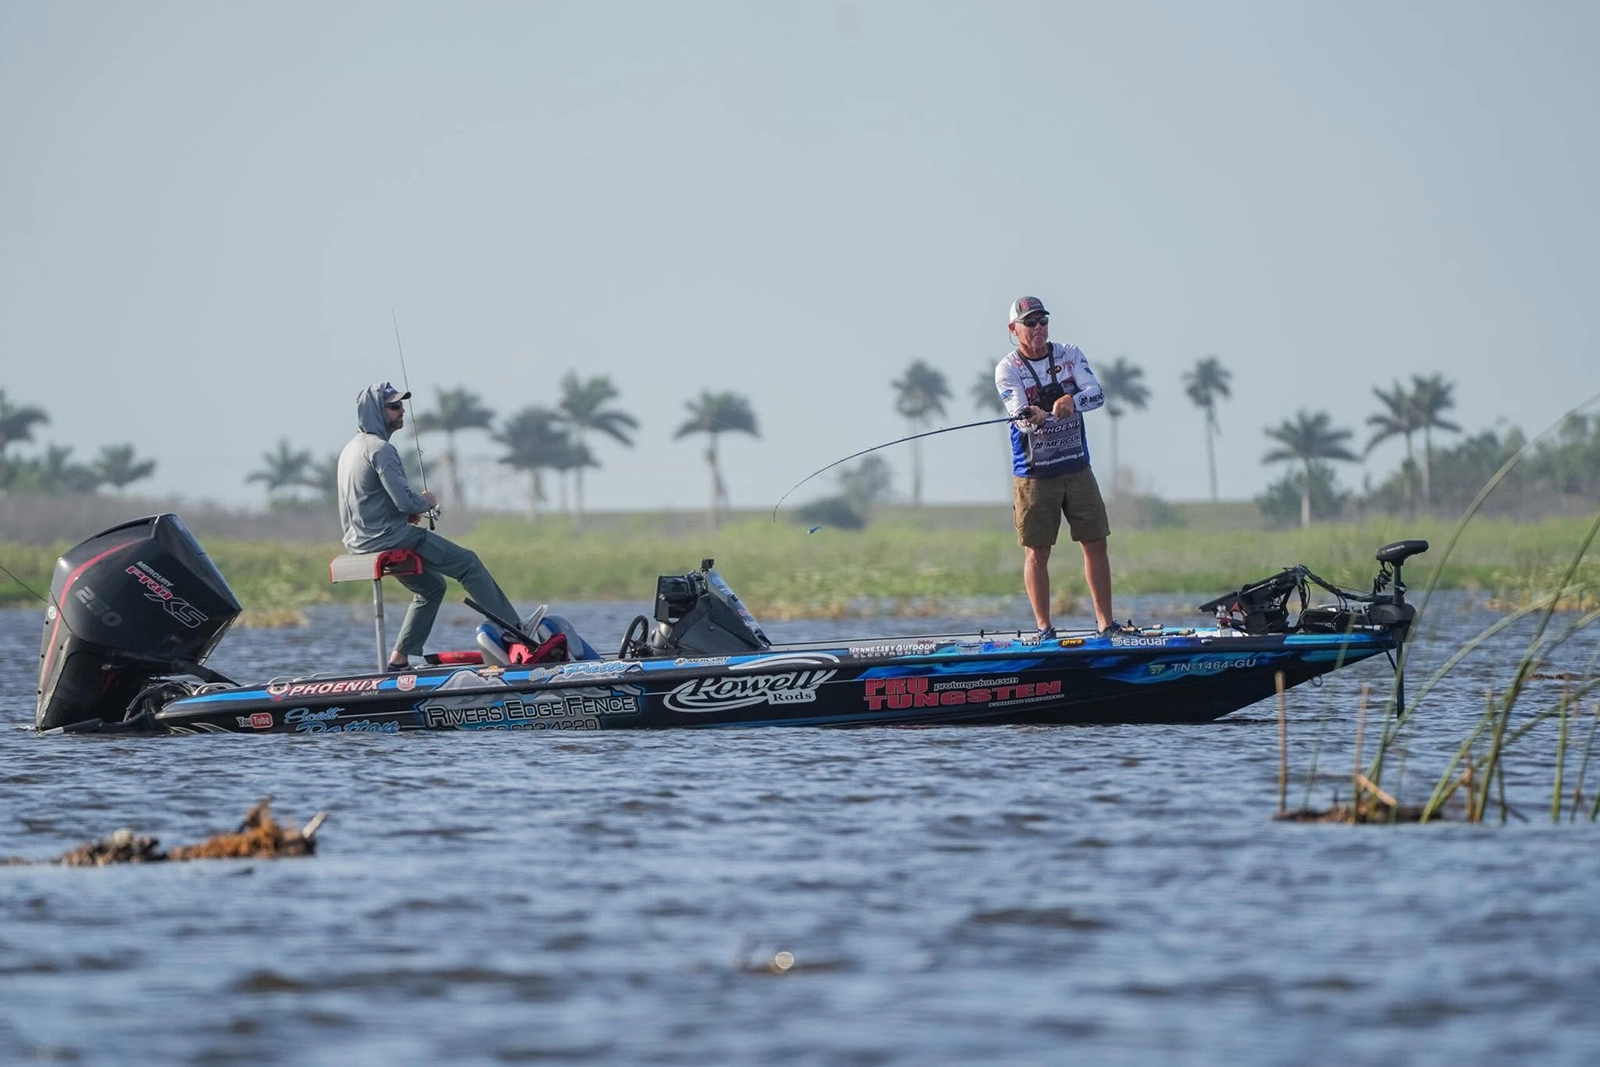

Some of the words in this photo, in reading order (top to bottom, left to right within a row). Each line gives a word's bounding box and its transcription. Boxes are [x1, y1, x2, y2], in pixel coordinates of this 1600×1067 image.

[136, 560, 174, 587] MERCURY
[1171, 658, 1257, 672] TN-1464-GU
[288, 677, 384, 696] PHOENIX
[865, 676, 929, 696] PRO
[933, 676, 1019, 692] protungsten.com
[773, 691, 812, 702] Rods
[863, 680, 1062, 711] TUNGSTEN
[426, 704, 502, 727] RIVERS
[563, 694, 636, 715] FENCE
